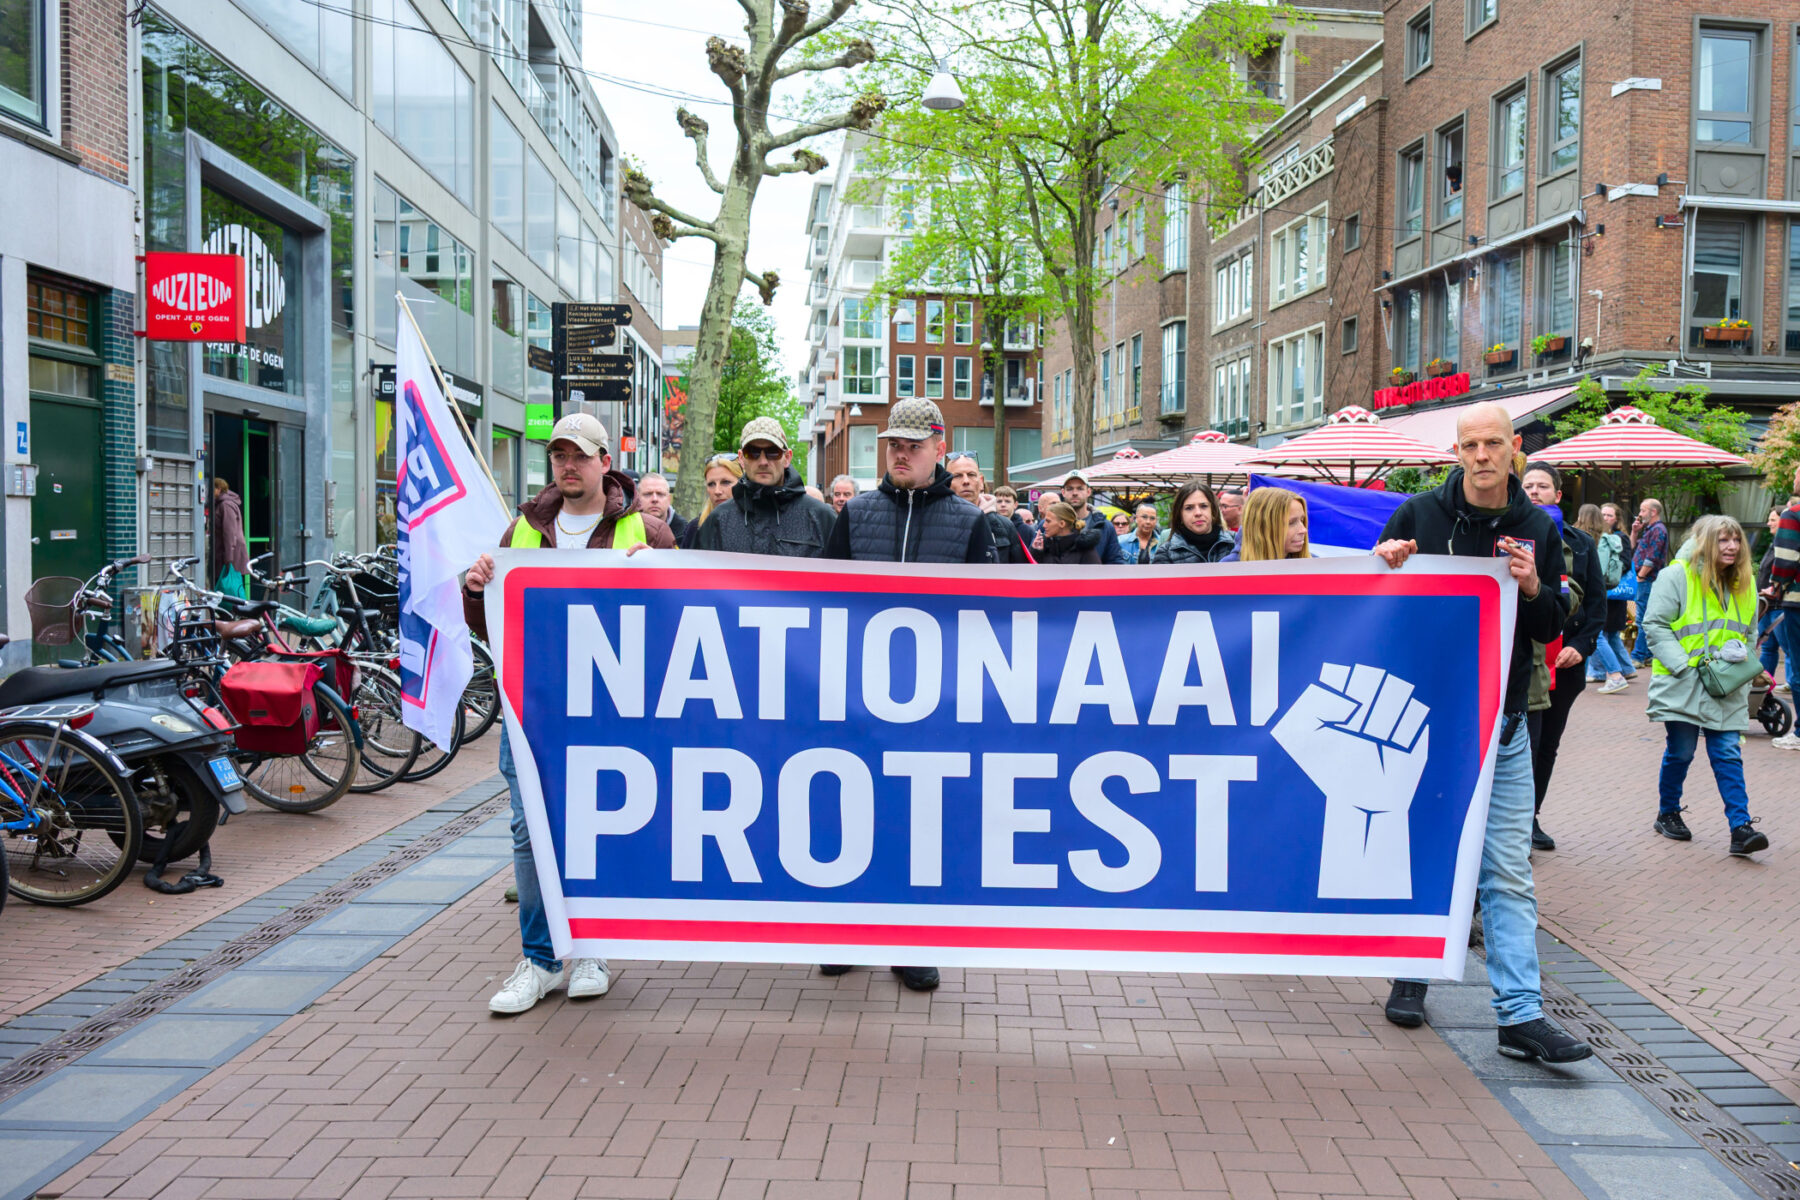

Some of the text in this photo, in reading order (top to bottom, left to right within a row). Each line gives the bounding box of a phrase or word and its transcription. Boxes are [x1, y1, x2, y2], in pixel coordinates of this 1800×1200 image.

[153, 272, 231, 311] MUZIEUM
[250, 347, 261, 362] DE
[263, 351, 284, 369] OGEN
[565, 745, 1258, 893] PROTEST
